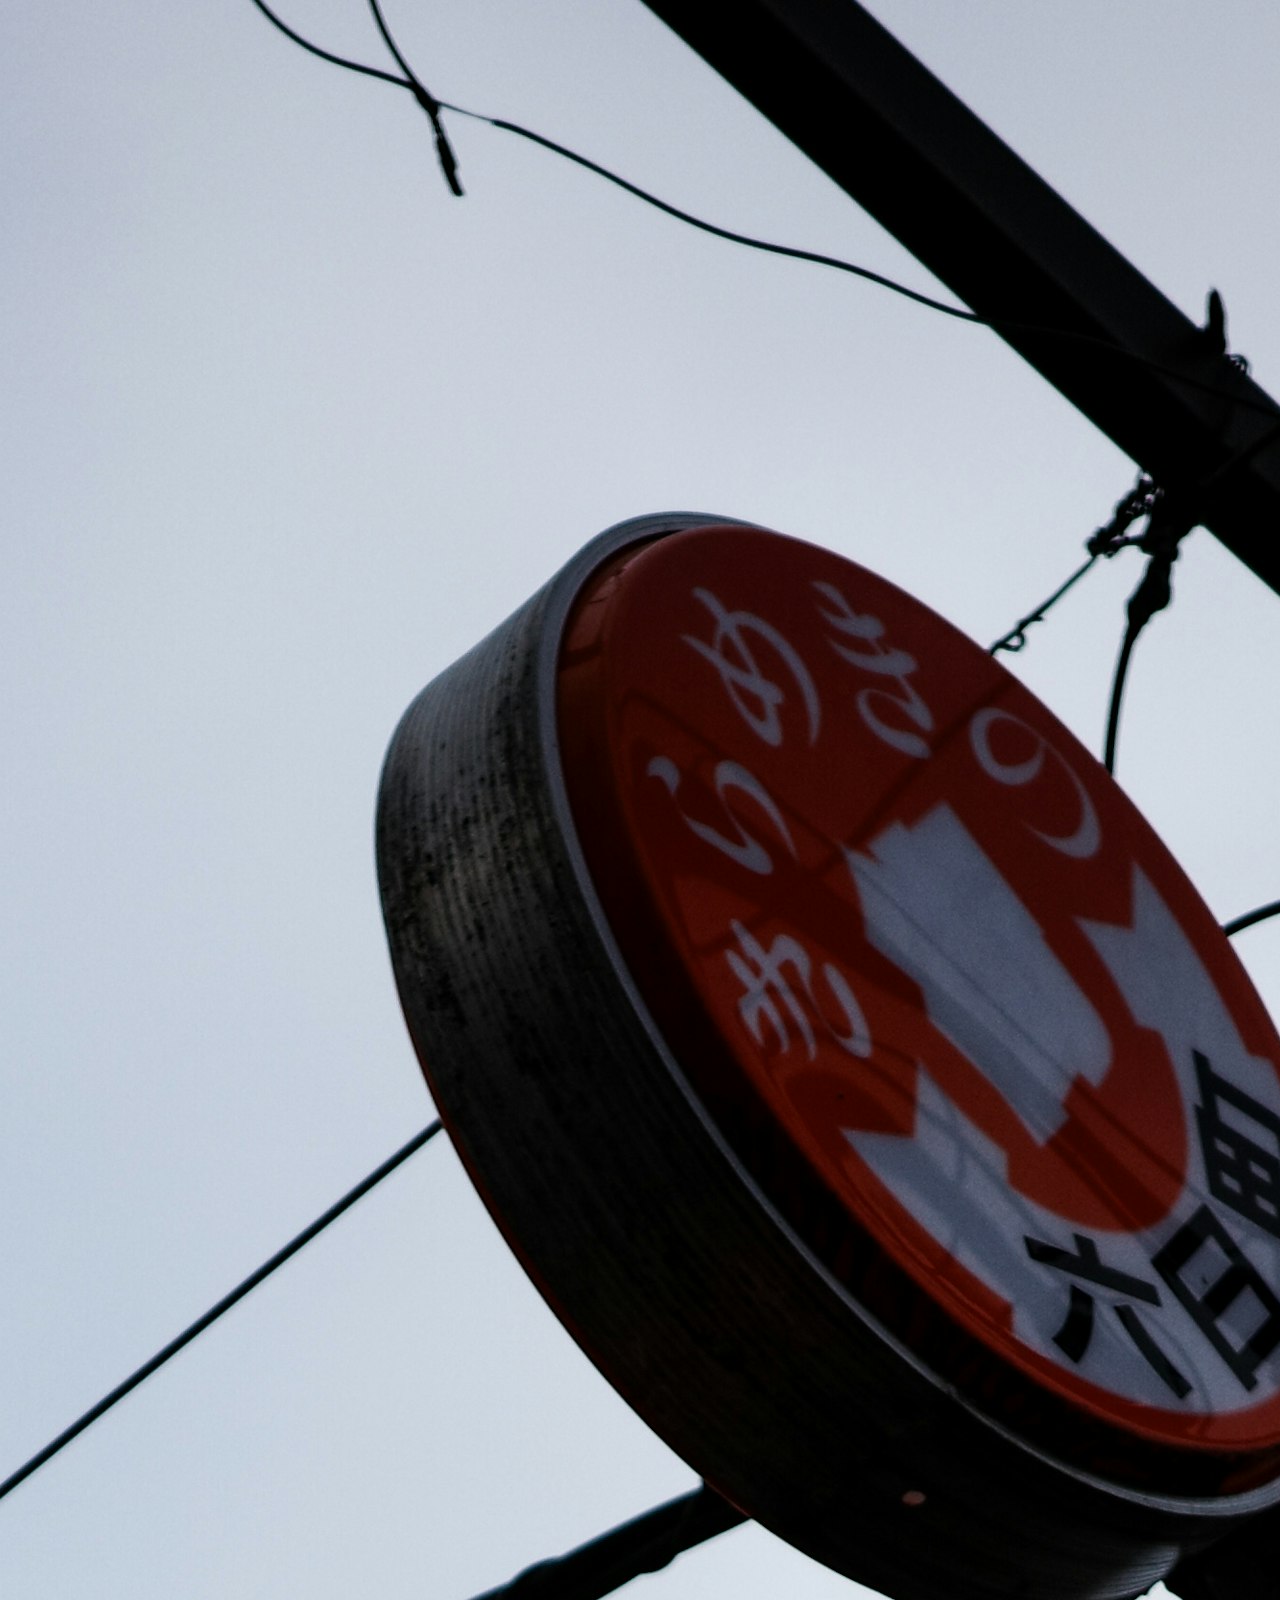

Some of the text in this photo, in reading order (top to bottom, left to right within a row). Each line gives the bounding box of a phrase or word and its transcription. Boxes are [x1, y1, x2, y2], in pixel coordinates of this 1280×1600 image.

[648, 579, 1103, 1062] きらめきの
